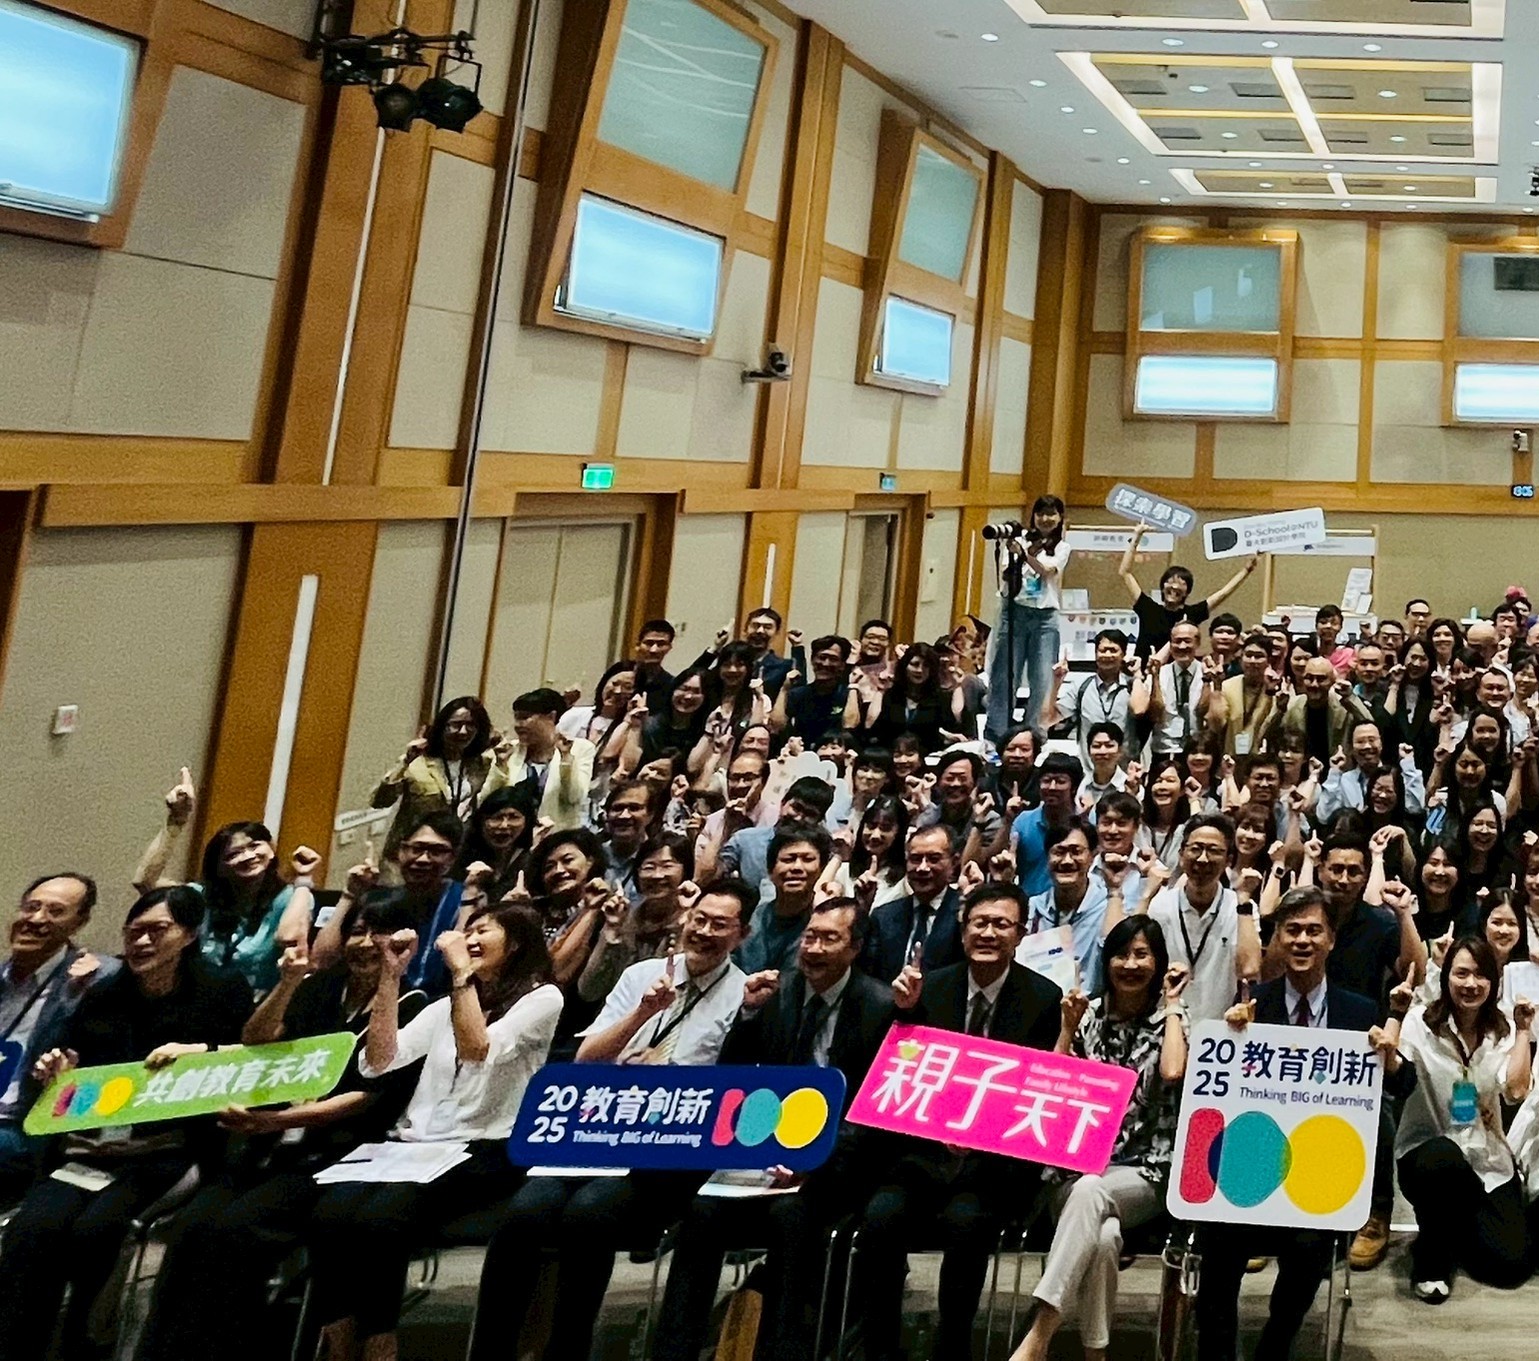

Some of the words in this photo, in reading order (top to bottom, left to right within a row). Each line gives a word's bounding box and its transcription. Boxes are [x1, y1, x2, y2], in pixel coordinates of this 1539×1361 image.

[1198, 1038, 1236, 1065] 20
[1241, 1040, 1378, 1087] 教育創新
[133, 1049, 331, 1107] 共創教育未來
[1192, 1070, 1230, 1097] 25
[538, 1085, 579, 1113] 20
[579, 1085, 714, 1125] 教育創新
[871, 1039, 1110, 1154] 親子天下
[1240, 1086, 1287, 1104] Thinking
[1290, 1090, 1310, 1103] BIG
[1312, 1091, 1325, 1103] of
[1325, 1093, 1375, 1111] Learning
[527, 1116, 569, 1144] 25
[573, 1129, 620, 1147] Thinking
[620, 1131, 642, 1144] BIG
[641, 1130, 656, 1144] of
[654, 1131, 702, 1148] Learning
